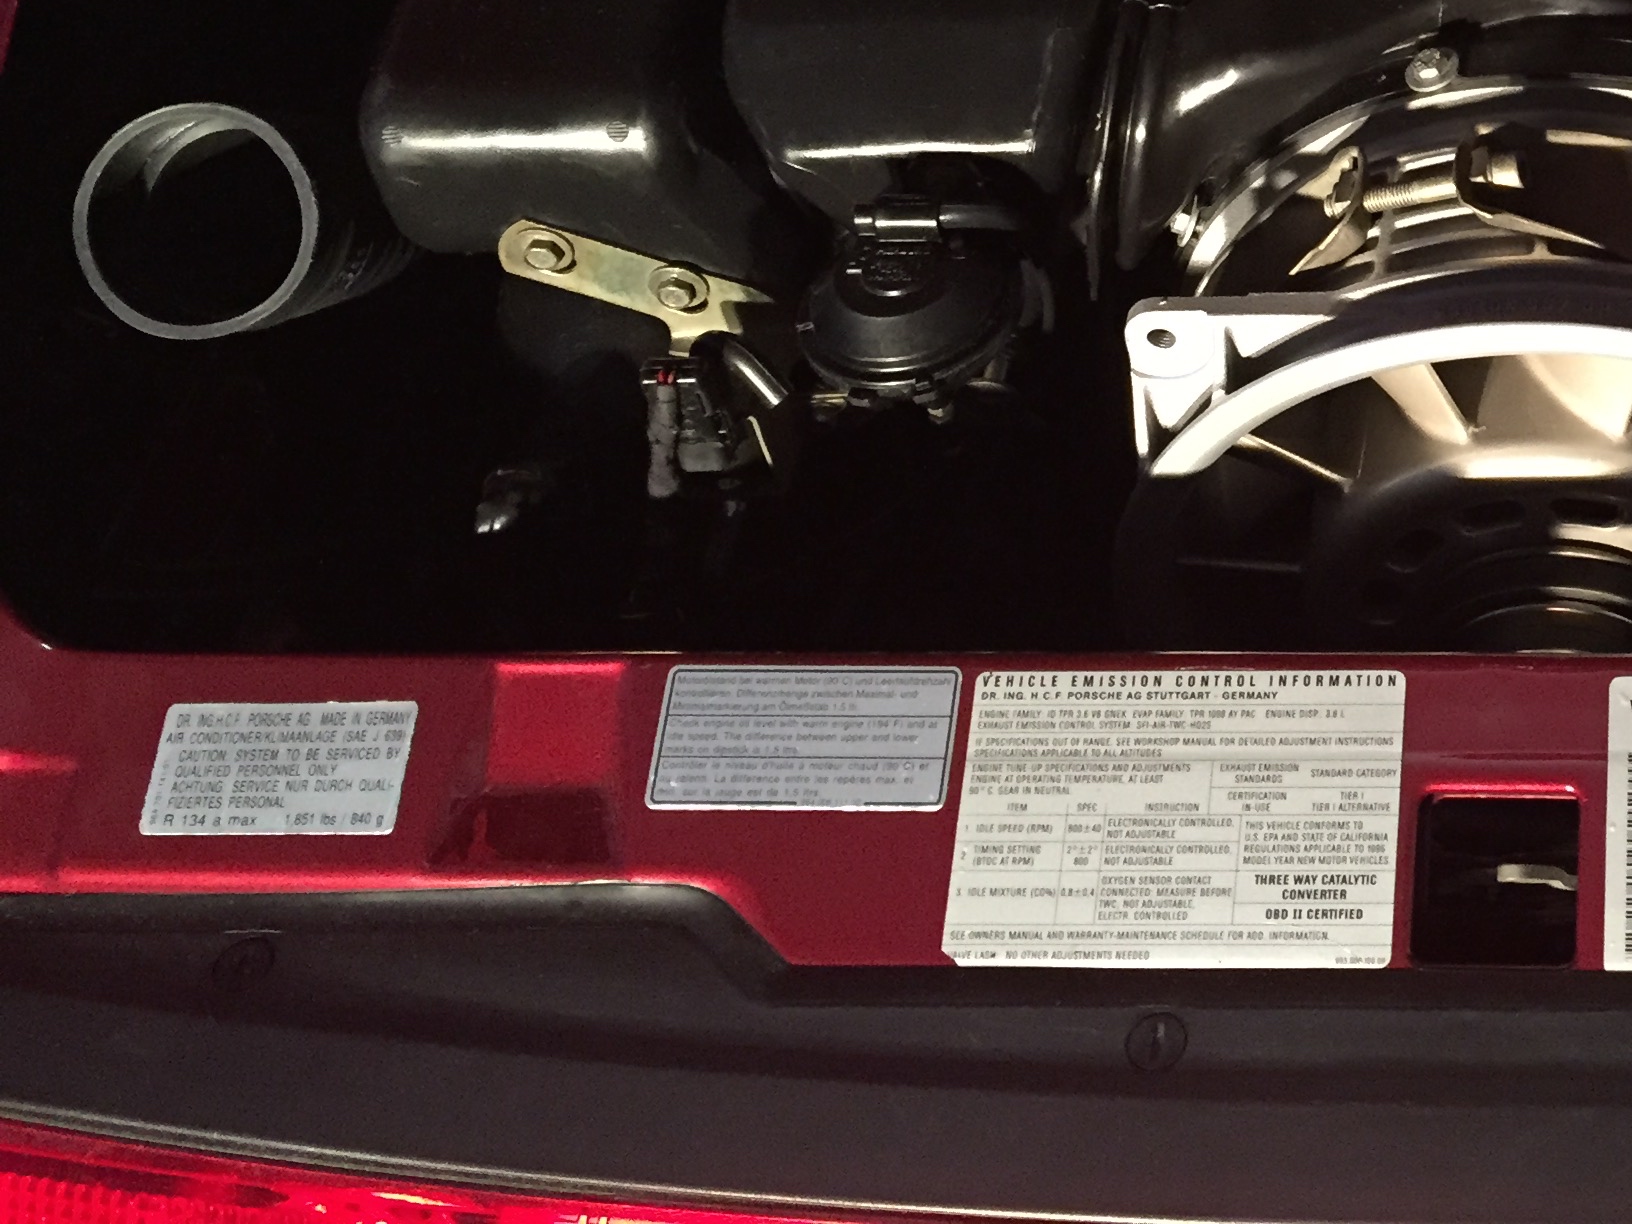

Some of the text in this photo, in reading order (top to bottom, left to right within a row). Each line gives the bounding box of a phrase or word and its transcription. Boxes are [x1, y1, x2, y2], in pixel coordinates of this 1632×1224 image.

[983, 675, 1397, 687] VEHICLE EMISSION CONTROL INFORMATION
[1067, 692, 1122, 700] PORSCHE
[1126, 692, 1142, 700] AG
[1146, 692, 1210, 700] STUTTGART
[1222, 692, 1278, 700] GERMANY
[1266, 710, 1296, 719] ENGINE
[1059, 721, 1095, 729] CONTROL
[1134, 738, 1180, 746] WORKSHOP
[1182, 738, 1216, 746] MANUAL
[1220, 738, 1235, 746] FOR
[1238, 738, 1276, 746] DETAILED
[1279, 738, 1332, 746] ADJUSTMENT
[1335, 738, 1394, 746] INSTRUCTIONS
[178, 748, 400, 762] CAUTION SYSTEM TO BE SERVICED BY
[1103, 749, 1116, 757] ALL
[174, 764, 339, 777] QUALIFIED PERSONNEL ONLY
[1112, 764, 1129, 772] AND
[1131, 764, 1191, 772] ADJUSTMENTS
[1258, 764, 1299, 772] EMISSION
[1311, 769, 1397, 777] STANDARD CATEGORY
[170, 779, 223, 793] ACHTUNG
[232, 779, 279, 793] SERVICE
[285, 779, 308, 793] NUR
[314, 779, 352, 793] DURCH
[1227, 792, 1287, 800] CERTIFICATION
[228, 796, 286, 809] PERSONAL
[1007, 803, 1028, 811] ITEM
[1339, 803, 1390, 811] ALTERNATIVE
[164, 814, 174, 827] R
[182, 814, 206, 827] 134
[228, 816, 257, 826] max
[350, 814, 371, 827] 840
[1108, 818, 1174, 827] ELECTRONICALLY
[1267, 821, 1363, 830] VEHICLE CONFORMS TO
[1107, 830, 1176, 838] NOT ADJUSTABLE
[1302, 833, 1388, 841] STATE OF CALIFORNIA
[1007, 845, 1041, 854] SETTING
[1244, 845, 1364, 853] REGULATIONS APPLICABLE TO
[1243, 856, 1347, 865] MODEL YEAR NEW MOTOR
[1101, 876, 1211, 885] OXYGEN SENSOR CONTACT
[1255, 874, 1377, 885] THREE WAY CATALYTIC
[989, 888, 1027, 897] MIXTURE
[1282, 889, 1347, 900] CONVERTER
[1265, 909, 1363, 919] OBD II CERTIFIED
[1009, 931, 1043, 940] MANUAL
[1047, 931, 1064, 940] AND
[1006, 951, 1018, 960] NO
[1051, 951, 1112, 960] ADJUSTMENTS
